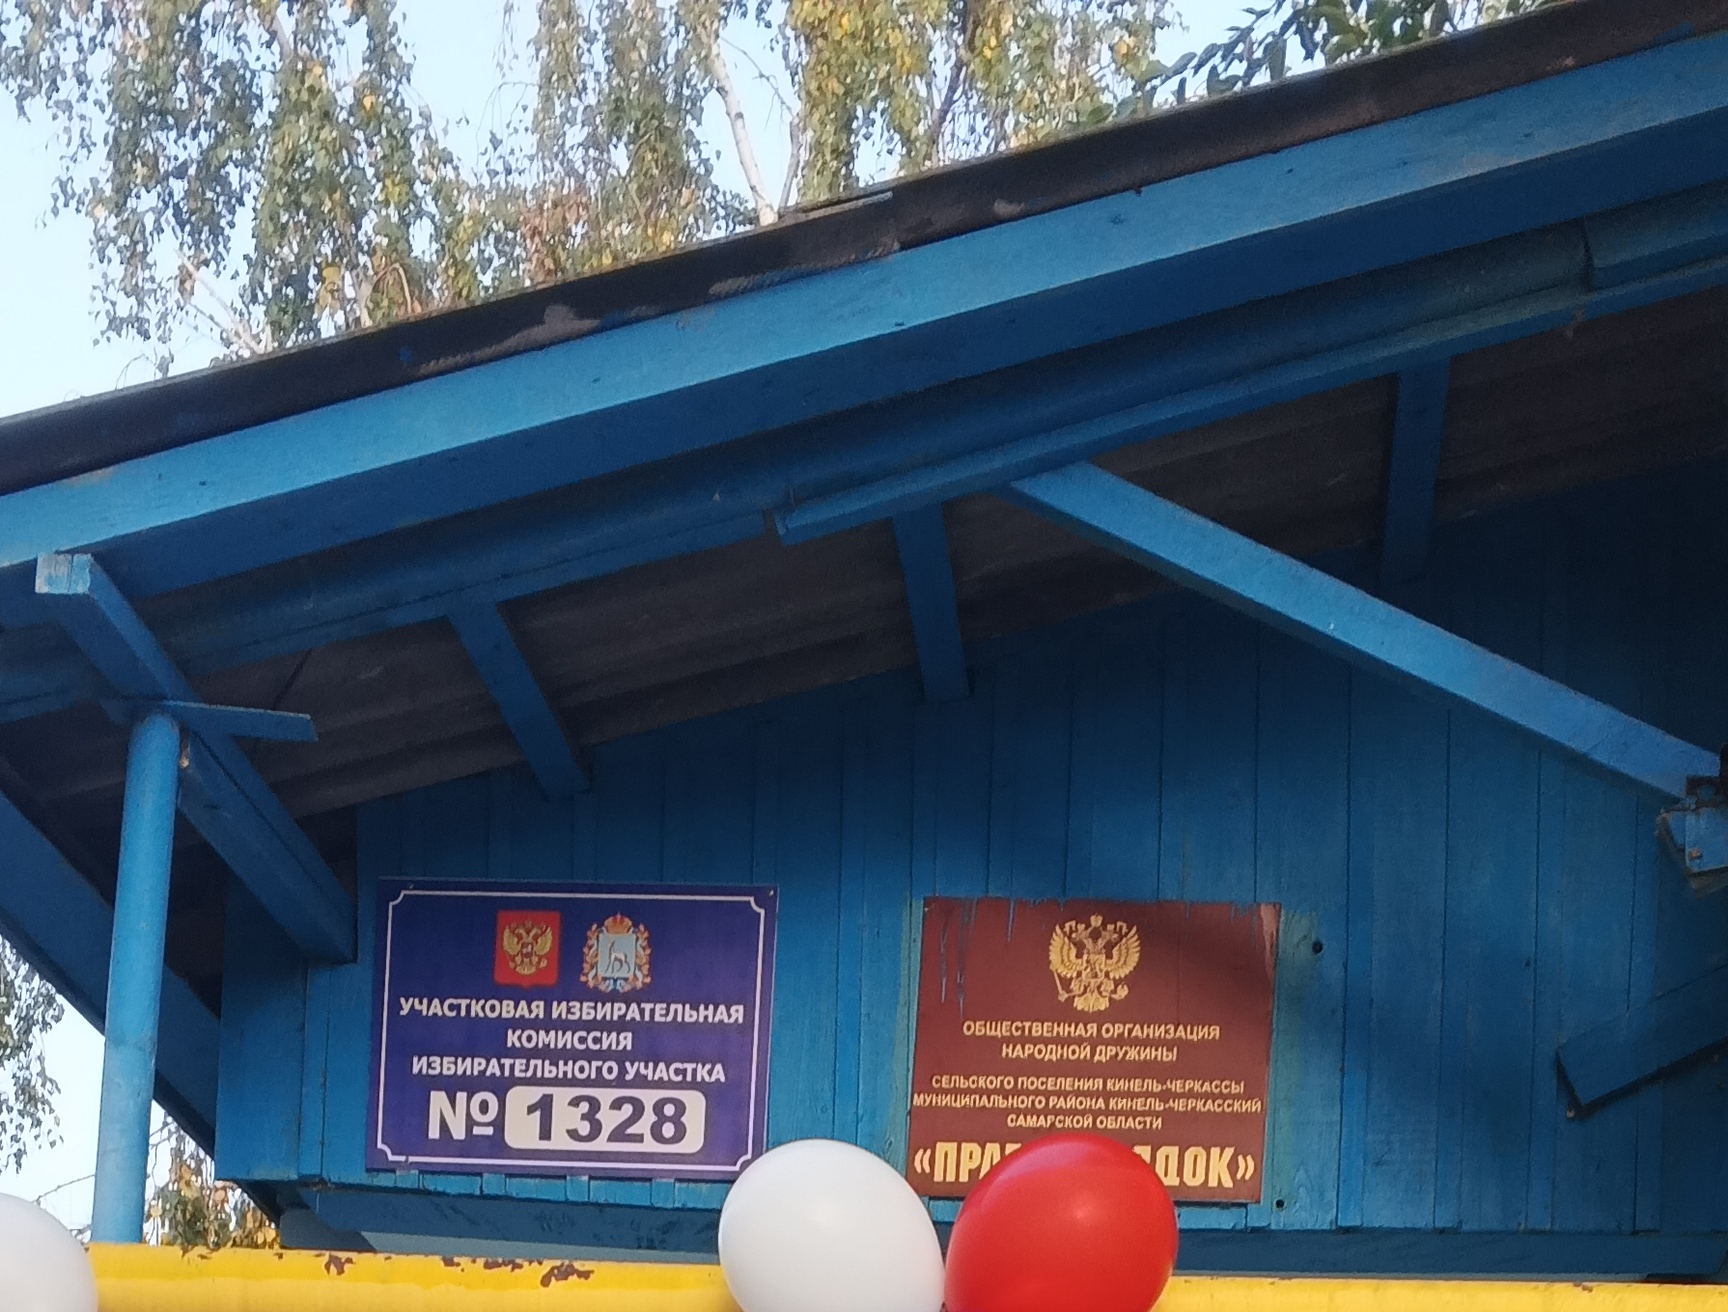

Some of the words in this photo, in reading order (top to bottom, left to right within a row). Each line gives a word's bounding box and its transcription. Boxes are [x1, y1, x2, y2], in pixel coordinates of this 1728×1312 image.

[400, 997, 544, 1019] УЧАСТКОВАЯ
[552, 1001, 744, 1024] ИЗБИРАТЕЛЬНАЯ
[506, 1029, 632, 1050] КОМИССИЯ
[963, 1021, 1097, 1038] ОБЩЕСТВЕННАЯ
[1101, 1024, 1220, 1040] ОРГАНИЗАЦИЯ
[1002, 1042, 1091, 1061] НАРОДНОЙ
[1094, 1046, 1177, 1063] ДРУЖИНЫ
[412, 1056, 618, 1080] ИЗБИРАТЕЛЬНОГО
[625, 1062, 726, 1083] УЧАСТКА
[932, 1076, 1014, 1090] СЕЛЬСКОГО
[1018, 1077, 1102, 1091] ПОСЕЛЕНИЯ
[1107, 1078, 1244, 1094] КИНЕЛЬ-ЧЕРКАССЫ
[913, 1093, 1045, 1109] МУНИЦИПАЛЬНОГО
[1049, 1093, 1105, 1110] РАЙОНА
[1109, 1098, 1261, 1113] КИНЕЛЬ-ЧЕРКАССКИЙ
[526, 1093, 687, 1144] 1328
[1007, 1112, 1093, 1128] САМАРСКОЙ
[1096, 1116, 1162, 1130] ОБЛАСТИ
